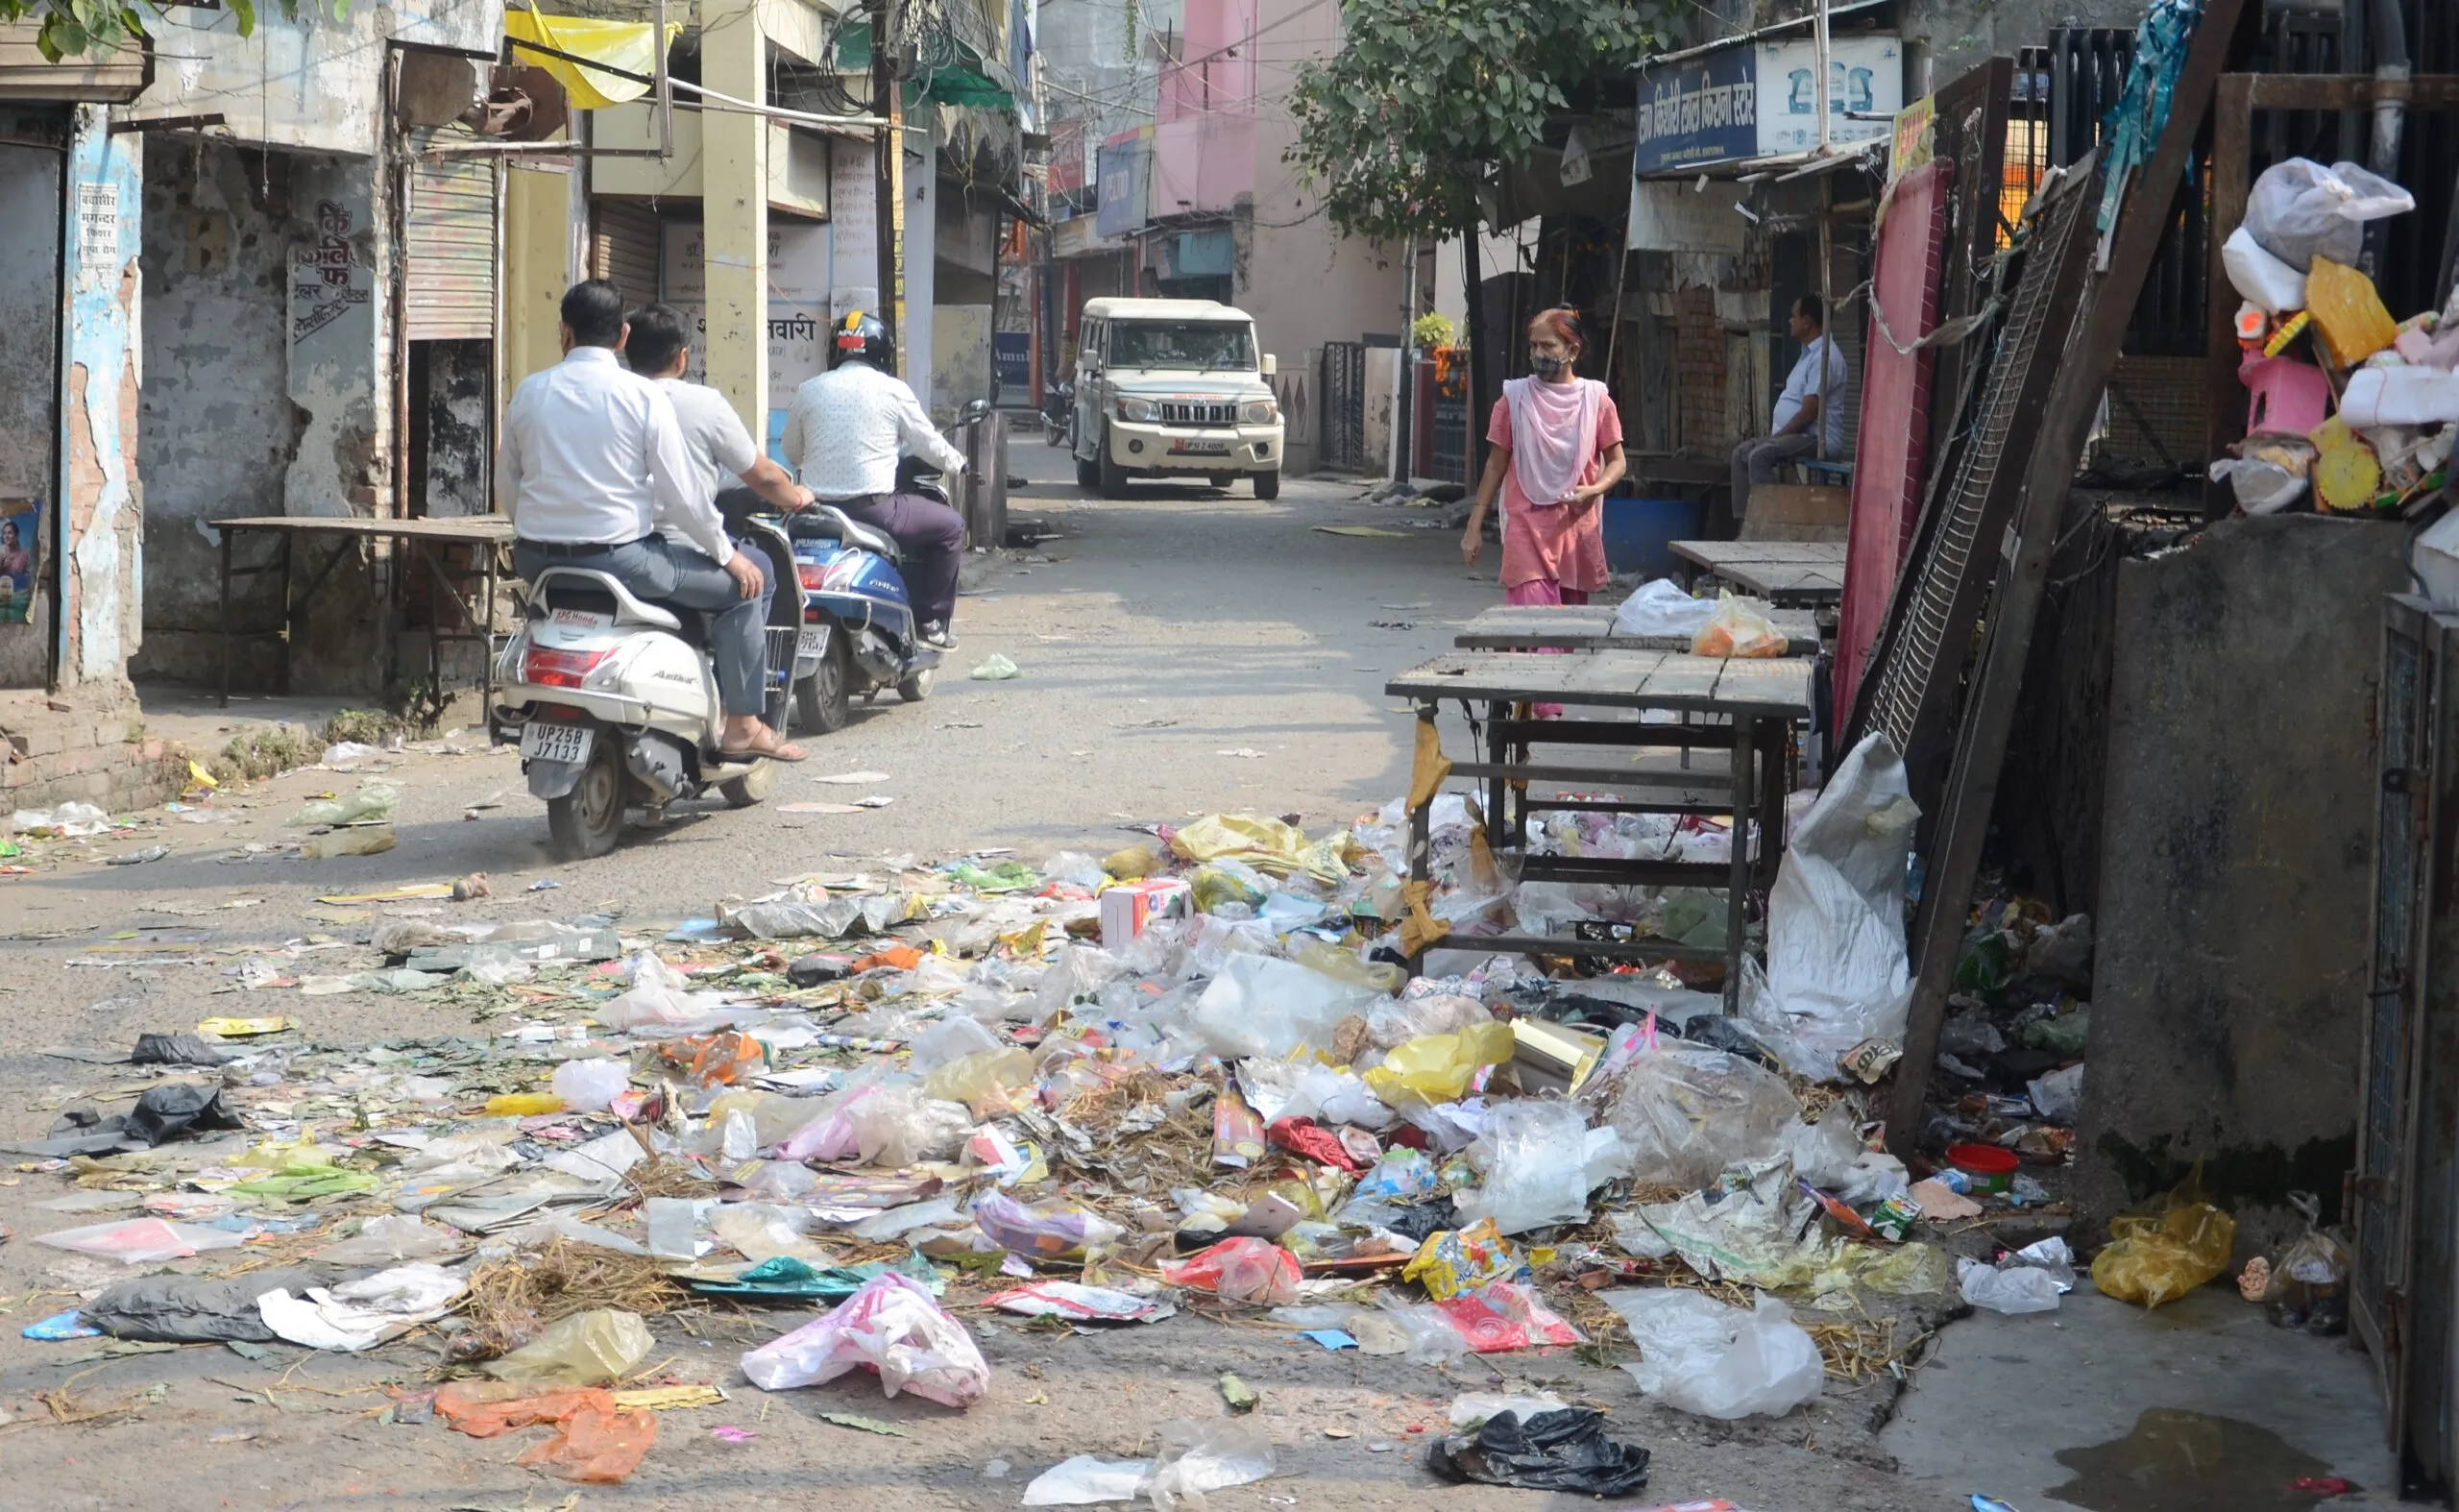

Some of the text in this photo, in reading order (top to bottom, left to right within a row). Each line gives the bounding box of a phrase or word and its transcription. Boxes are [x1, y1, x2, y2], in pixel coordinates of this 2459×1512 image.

[1654, 78, 1680, 138] किशोरी
[1681, 90, 1700, 134] लाल
[1701, 69, 1732, 129] किराना
[1733, 65, 1754, 126] स्टोर
[82, 194, 115, 206] बवासीर
[538, 724, 583, 744] UP25B
[534, 742, 579, 761] J7133
